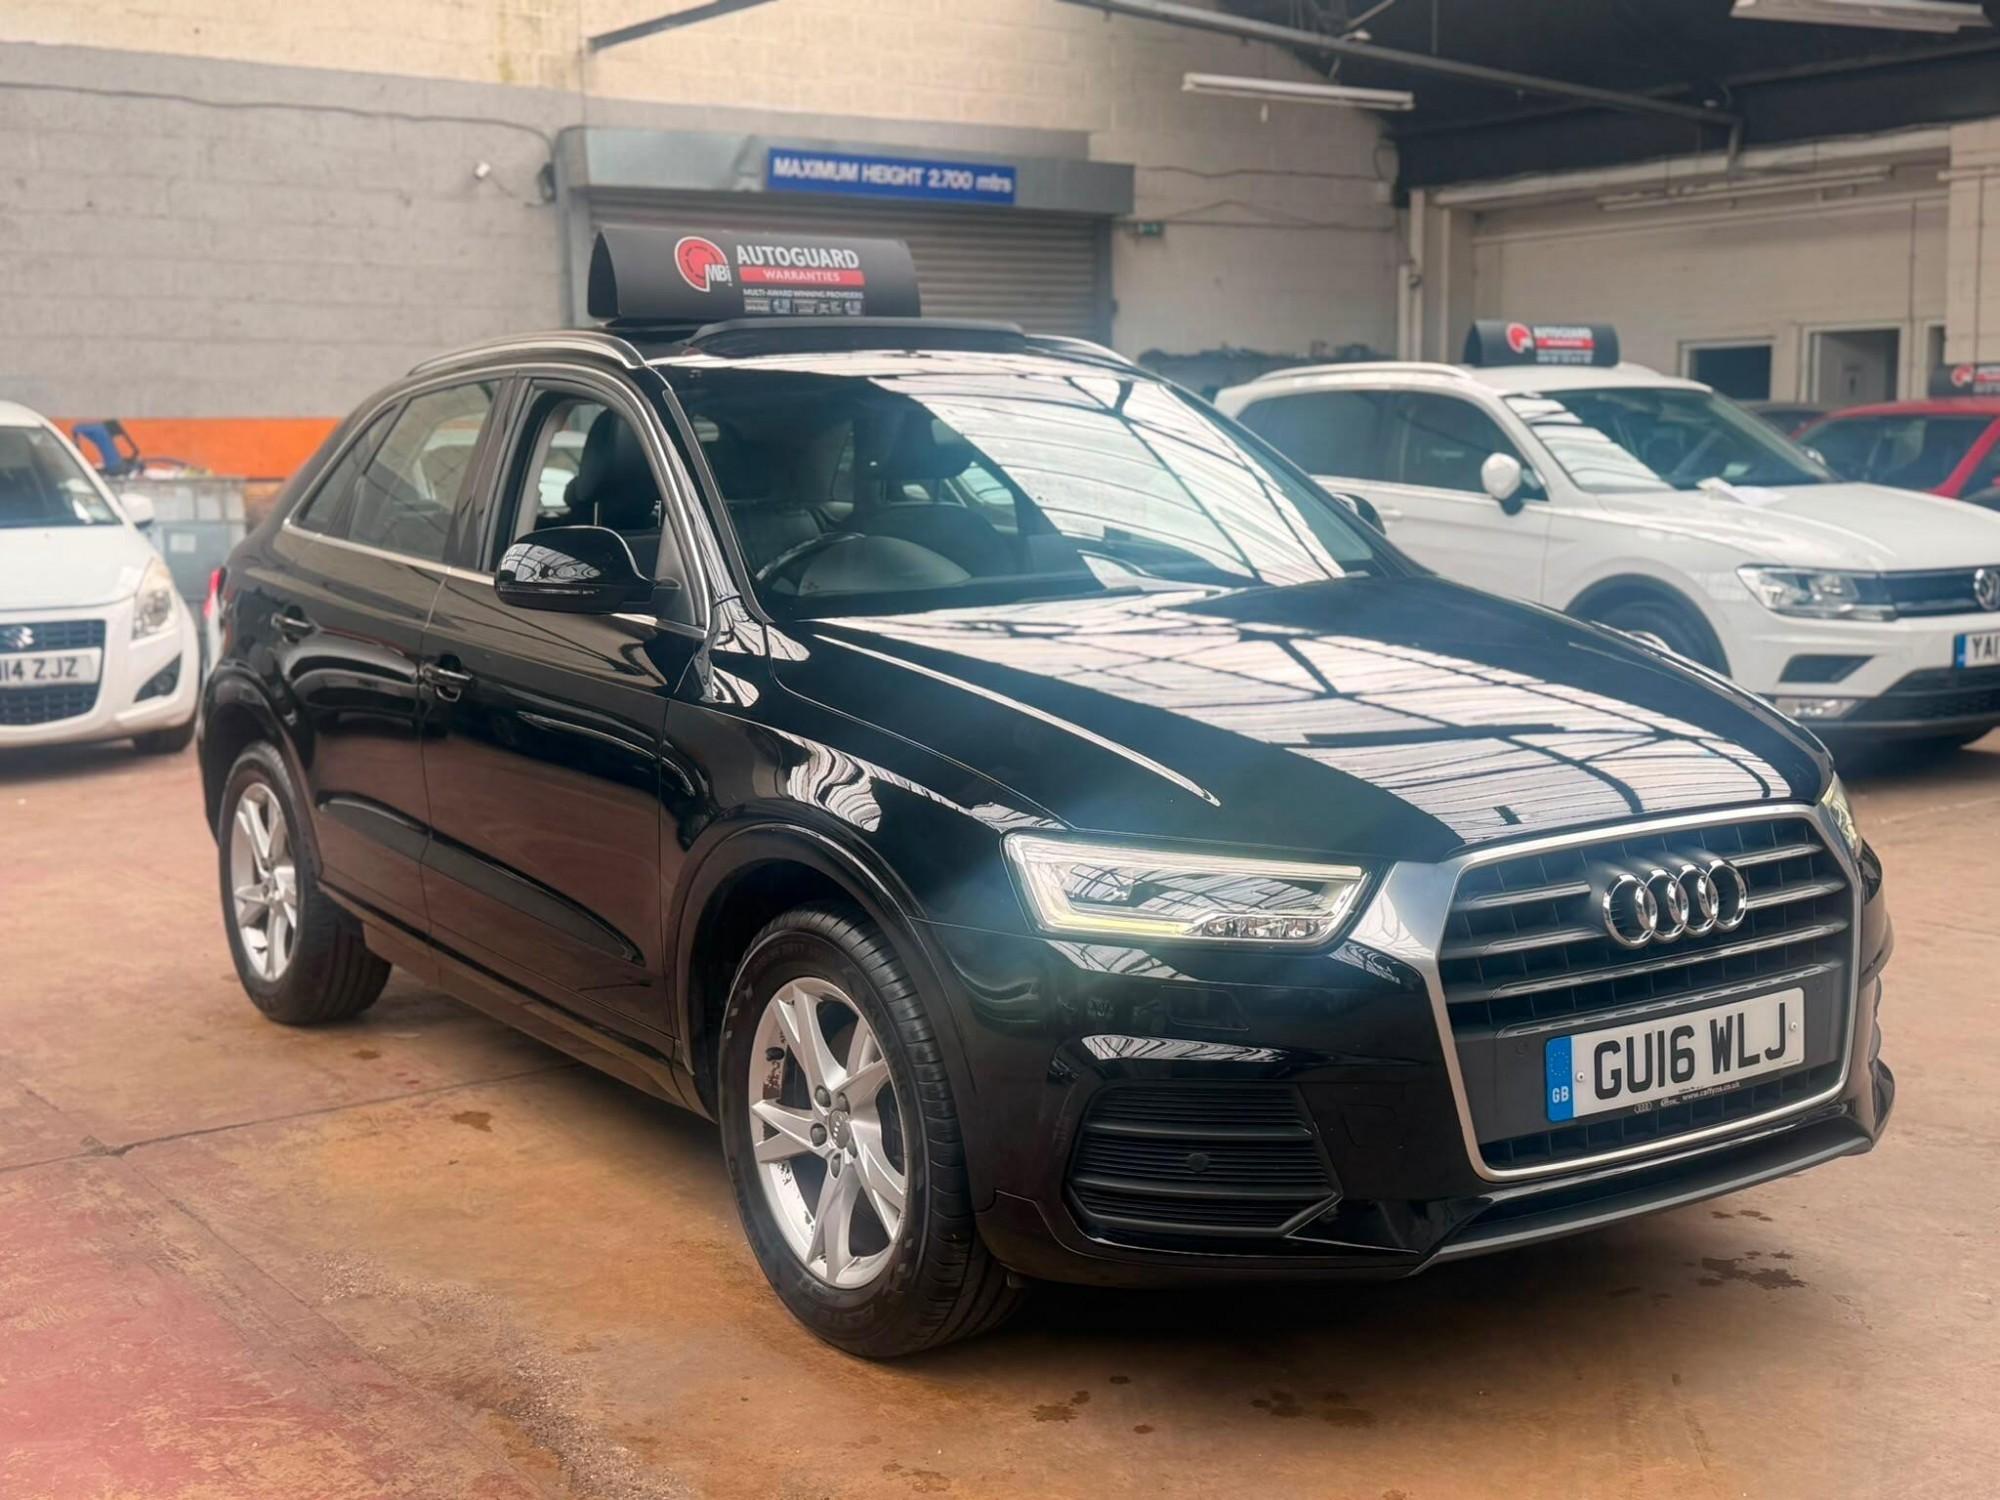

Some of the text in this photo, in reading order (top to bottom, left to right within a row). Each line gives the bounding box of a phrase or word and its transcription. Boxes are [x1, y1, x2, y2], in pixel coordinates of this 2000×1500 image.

[773, 157, 1013, 193] MAXIMUM HEIGHT 2.700 mtrs
[736, 245, 859, 268] AUTOGUARD
[763, 269, 840, 282] WARRANTIES
[32, 656, 78, 679] ZJZ
[1594, 1002, 1786, 1100] GU16 WLJ
[1552, 1087, 1569, 1104] GB
